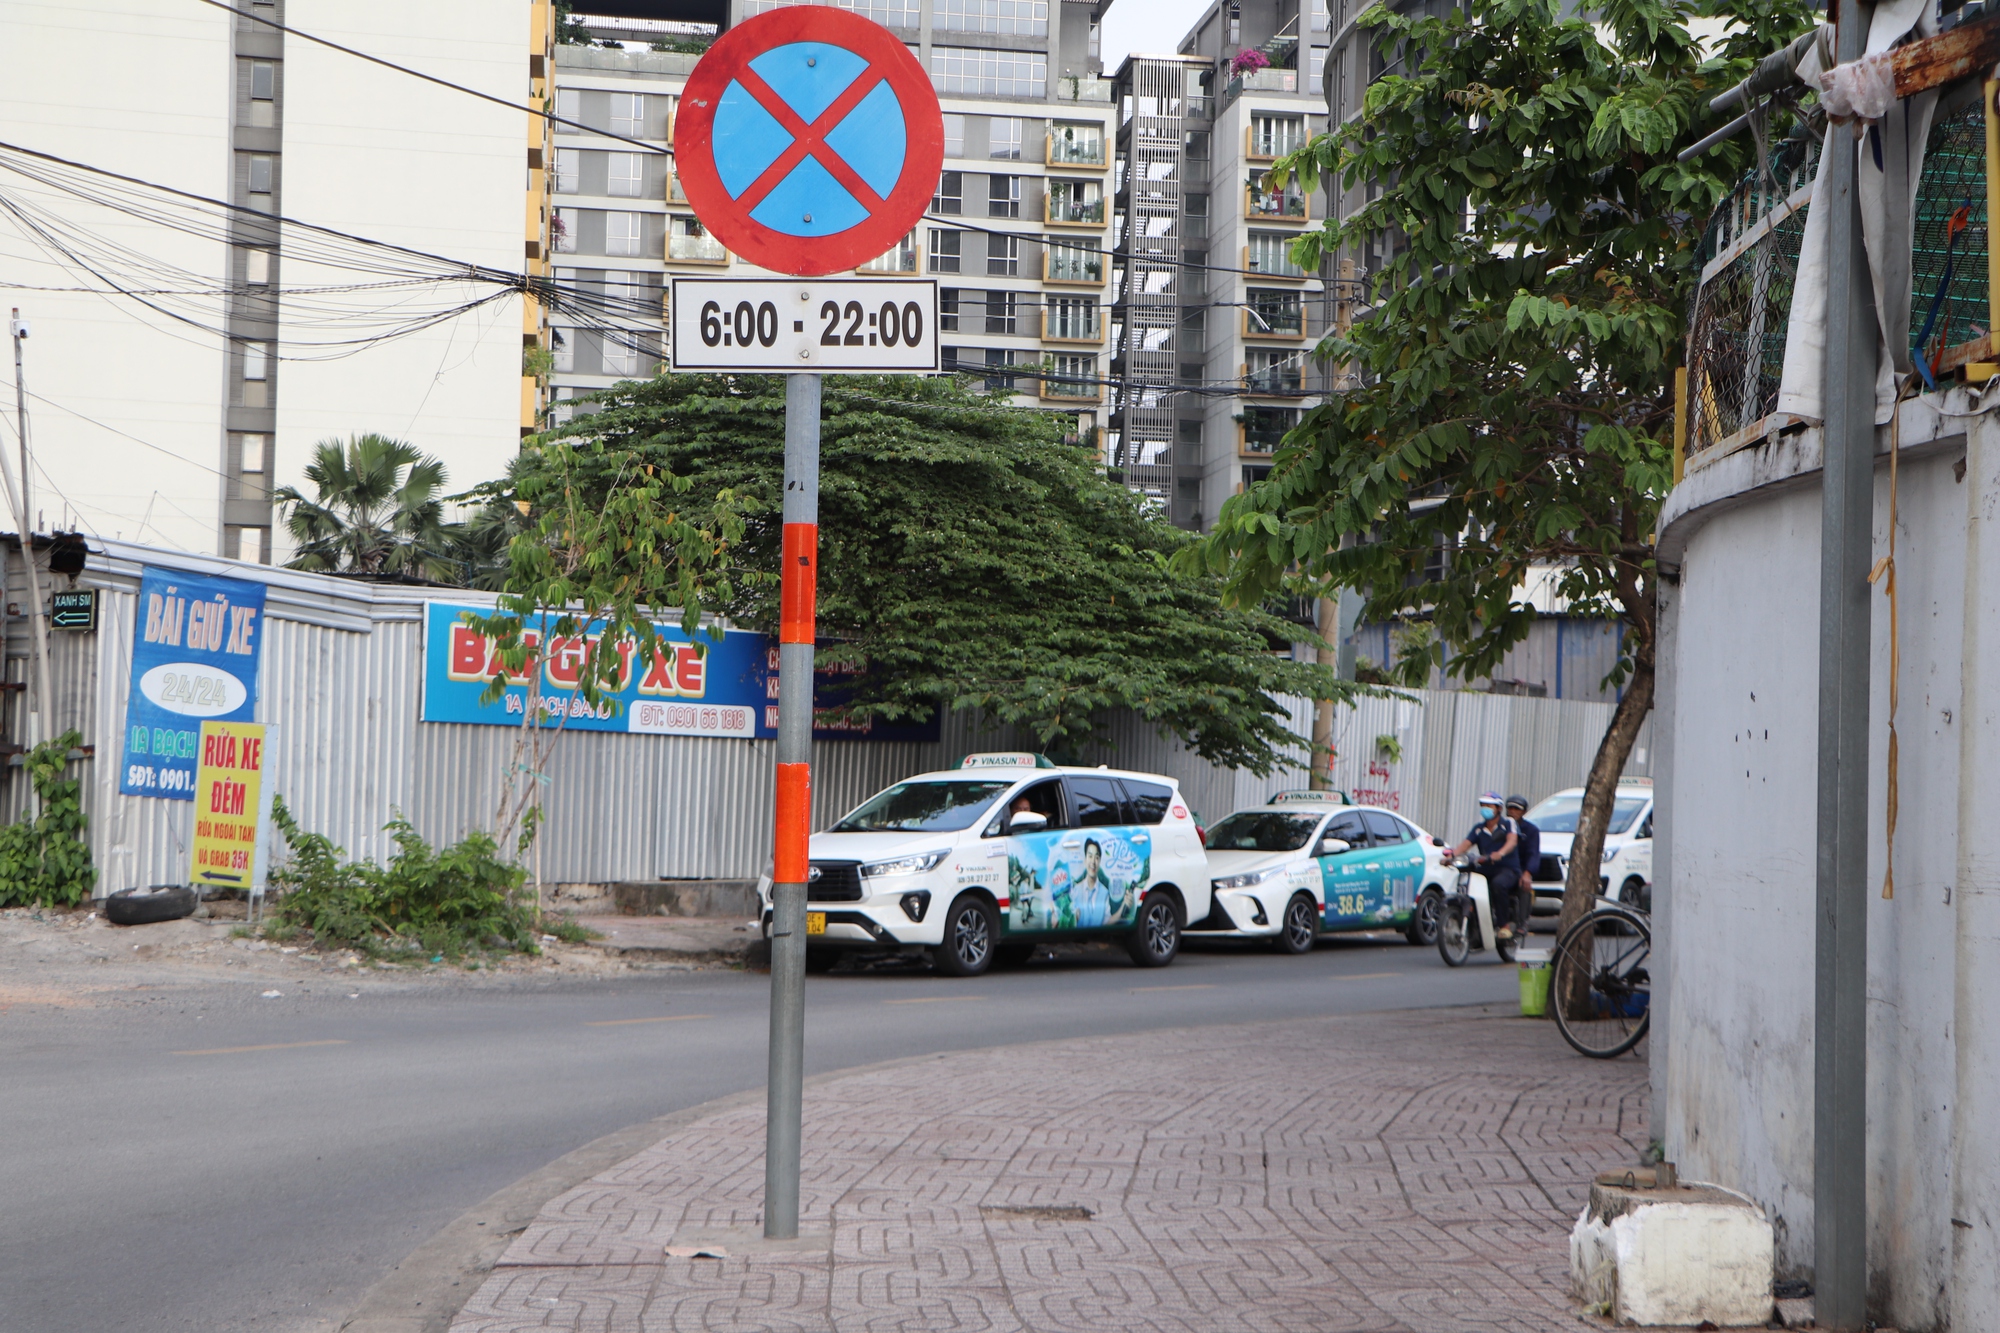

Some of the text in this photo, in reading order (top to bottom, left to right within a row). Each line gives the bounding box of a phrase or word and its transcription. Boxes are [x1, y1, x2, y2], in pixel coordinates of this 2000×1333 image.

[700, 300, 779, 347] 6:00
[820, 300, 923, 347] 22:00
[55, 594, 91, 607] XANH SM
[144, 586, 257, 655] BÃI GIỮ XE
[638, 640, 708, 698] XE
[161, 672, 226, 707] 24/24
[506, 694, 523, 714] 1A
[640, 704, 745, 730] ĐT: 0901 66 1818
[152, 728, 197, 763] BẠCH
[204, 727, 261, 771] RỬA XE
[981, 756, 1017, 765] VINASUN
[128, 764, 156, 788] SĐT:
[211, 776, 246, 816] ĐÊM
[239, 825, 255, 842] TAXI
[210, 849, 230, 867] GRAB
[232, 849, 249, 870] 35K
[1337, 893, 1365, 916] 38.6
